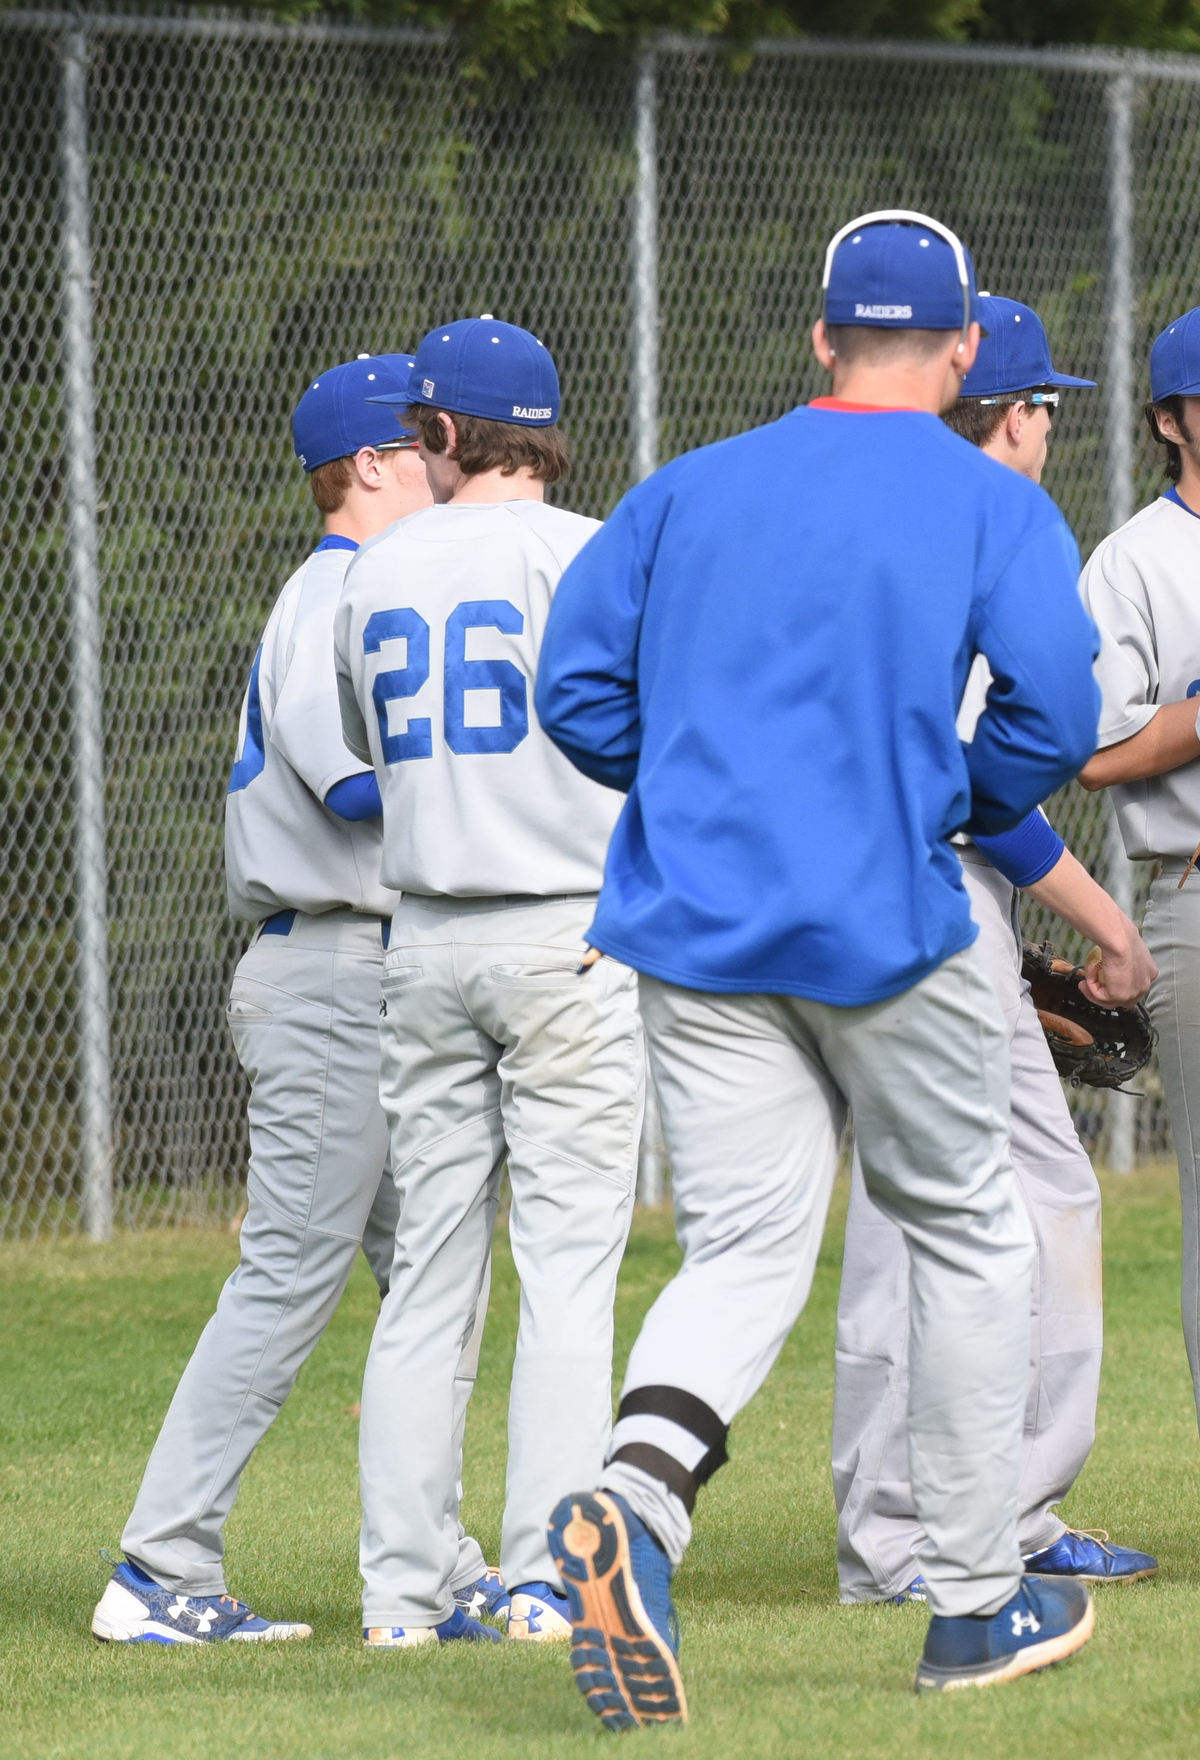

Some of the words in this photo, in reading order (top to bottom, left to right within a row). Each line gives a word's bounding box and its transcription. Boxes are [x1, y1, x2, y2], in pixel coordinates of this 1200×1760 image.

[855, 303, 913, 320] RAIDERS
[512, 406, 552, 419] RAIDERS
[363, 599, 529, 766] 26
